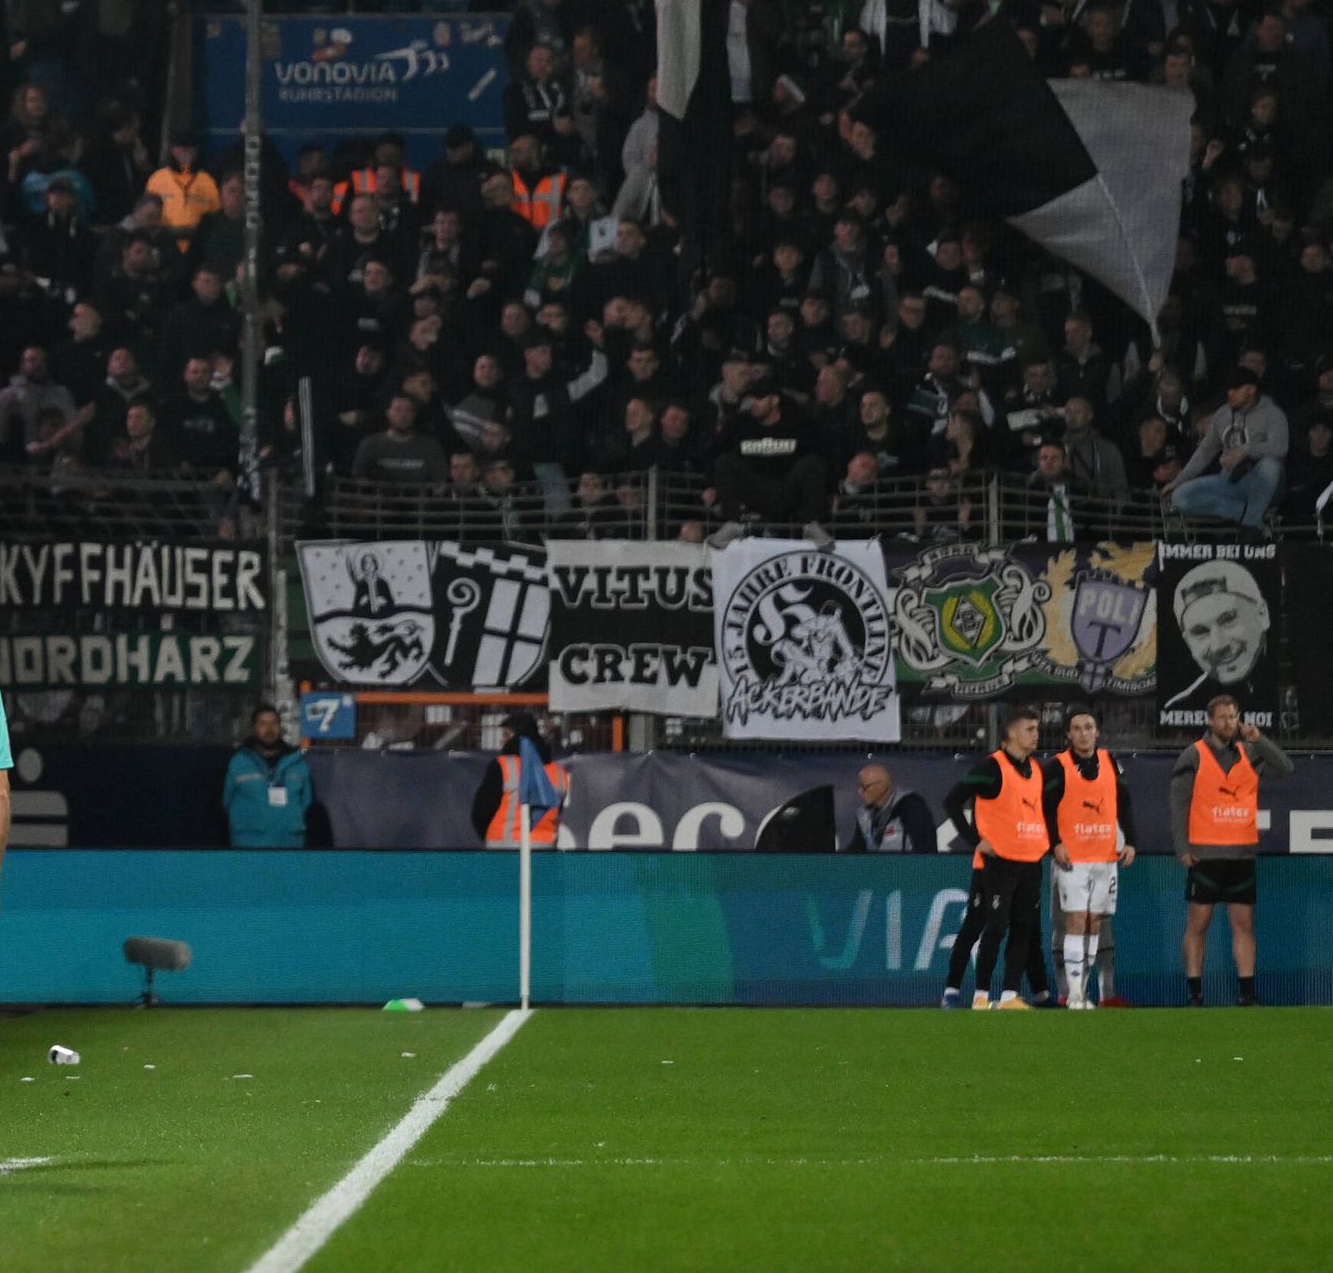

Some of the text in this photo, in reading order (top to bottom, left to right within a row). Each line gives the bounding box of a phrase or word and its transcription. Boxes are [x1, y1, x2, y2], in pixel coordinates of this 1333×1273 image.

[1159, 543, 1212, 560] IMMER
[1216, 544, 1240, 560] BEI
[553, 565, 713, 610] VITUS
[1078, 588, 1142, 624] POLI
[727, 560, 792, 636] JAHRE
[800, 557, 886, 675] FRONTLINE
[560, 644, 710, 687] CREW
[726, 670, 893, 727] ACKERBANDE
